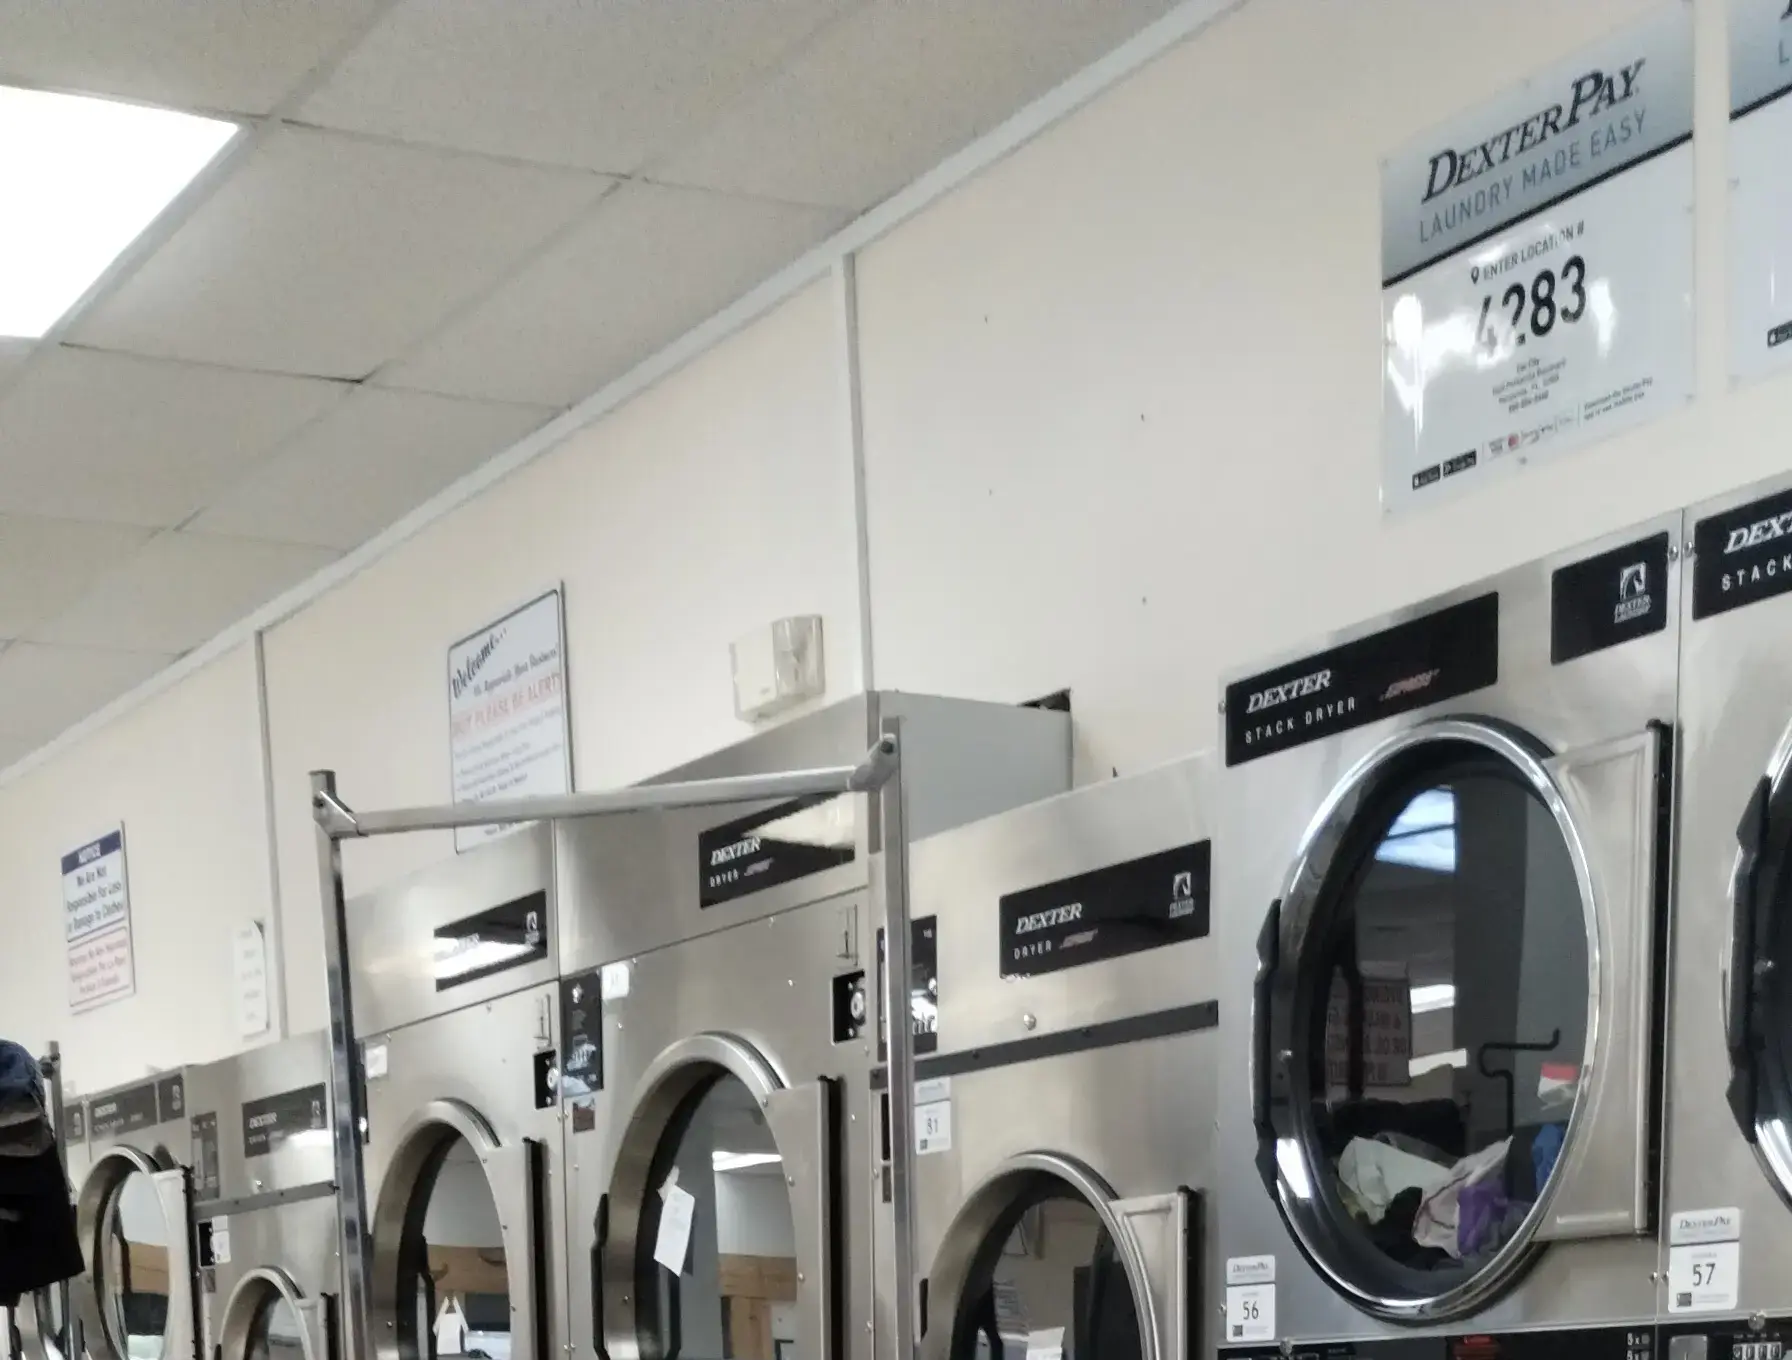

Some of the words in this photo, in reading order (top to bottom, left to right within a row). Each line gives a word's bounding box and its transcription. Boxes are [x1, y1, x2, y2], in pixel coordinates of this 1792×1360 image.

[1419, 175, 1514, 244] LAUNDRY
[1522, 139, 1581, 193] MADE
[1590, 107, 1647, 157] EASY
[1483, 254, 1519, 281] ENTER
[1721, 552, 1792, 592] STACK
[1245, 668, 1332, 714] DEXTER
[1244, 717, 1295, 744] STACK
[1305, 696, 1356, 726] DRYER
[710, 835, 762, 867] DEXTER
[1015, 902, 1083, 935] DEXTER
[1013, 940, 1053, 961] DRYER
[1692, 1263, 1717, 1287] 57
[1242, 1300, 1260, 1321] 56
